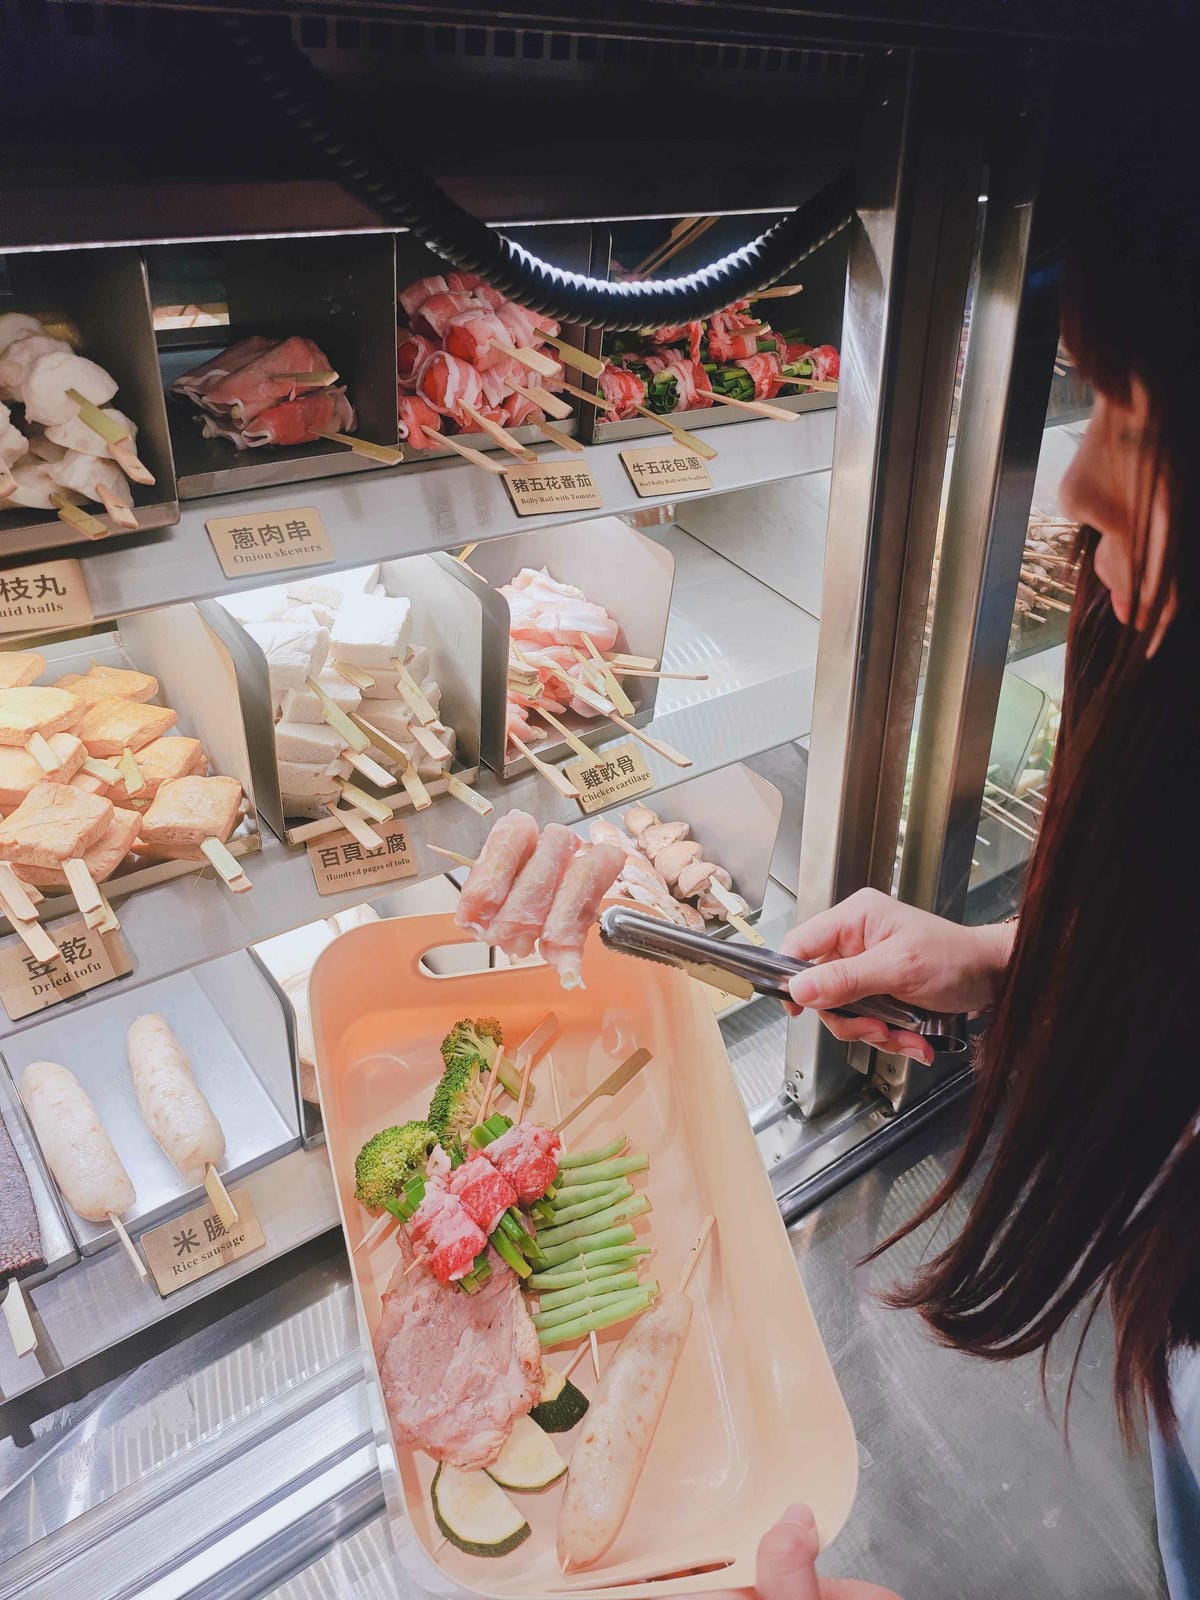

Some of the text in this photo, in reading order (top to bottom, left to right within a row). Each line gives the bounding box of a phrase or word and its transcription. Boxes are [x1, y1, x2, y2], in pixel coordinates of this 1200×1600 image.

[512, 473, 592, 493] 豬五花番茄
[521, 497, 538, 505] Belly
[570, 493, 596, 501] Tomato
[233, 544, 322, 564] Onion skewers
[27, 602, 64, 614] balls
[580, 754, 635, 790] 雞軟骨
[581, 772, 650, 803] Chicken cartilage
[326, 858, 410, 882] Hundred pages of tofu
[32, 961, 102, 996] Dried tofu
[172, 1233, 246, 1276] Rice sausage
